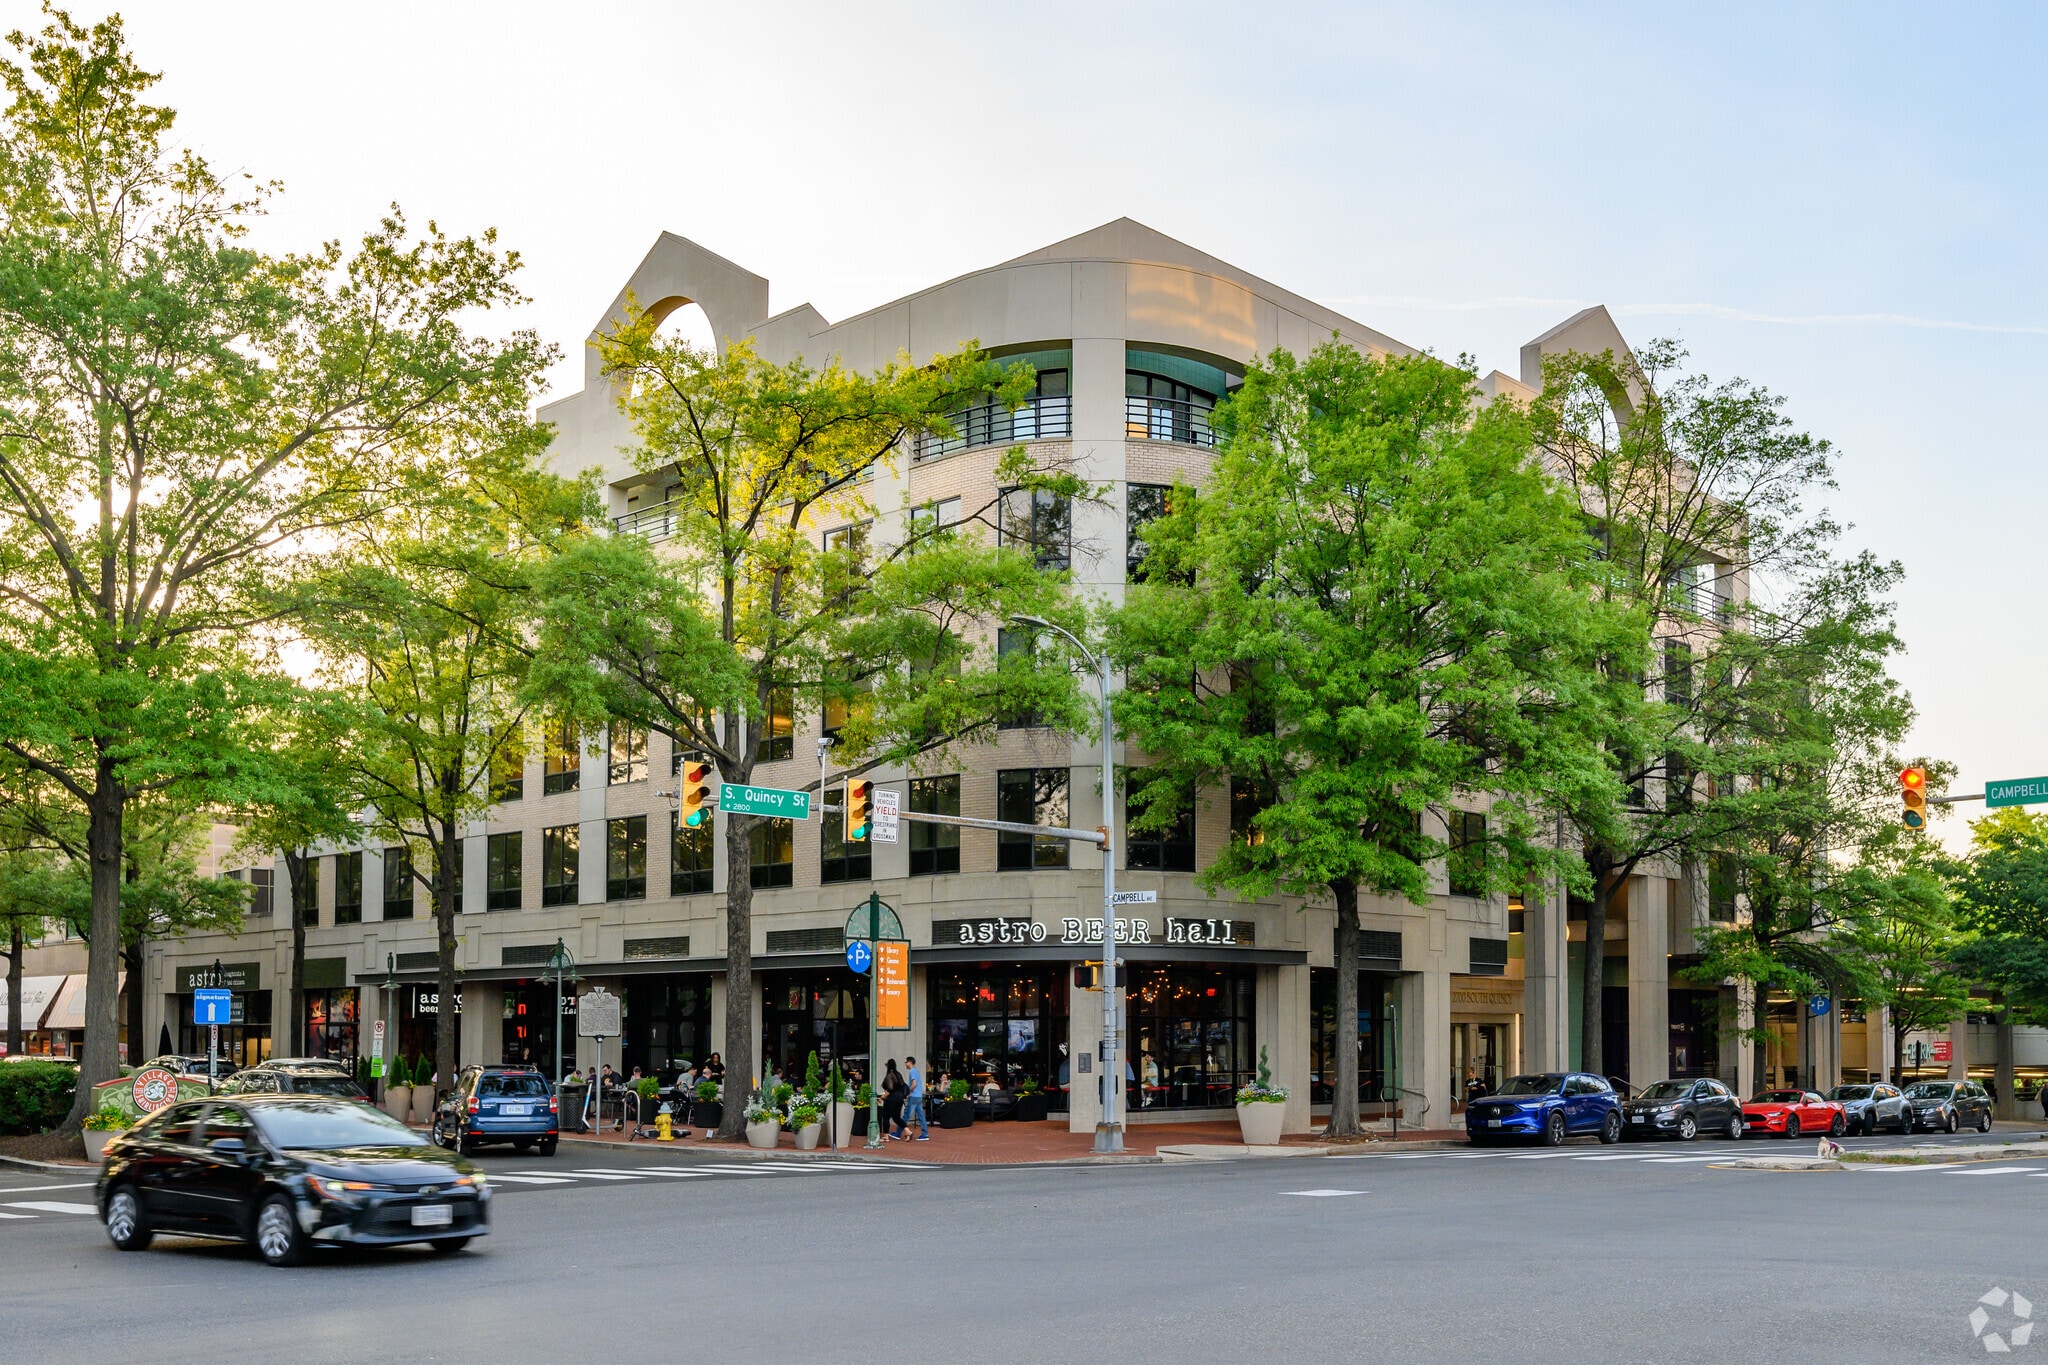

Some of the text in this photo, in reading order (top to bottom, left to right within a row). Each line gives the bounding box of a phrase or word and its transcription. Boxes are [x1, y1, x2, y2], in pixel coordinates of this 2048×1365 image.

[725, 787, 805, 807] S. Quincy St
[1991, 783, 2048, 799] CAMPBELL
[733, 803, 750, 811] 2800
[876, 806, 896, 816] YIELD
[1113, 893, 1145, 902] CAMPBELL
[959, 917, 1237, 944] astro BEER hall
[856, 950, 864, 964] P
[1466, 992, 1488, 1004] SOUTH
[1488, 992, 1512, 1004] QUINCY
[1818, 1000, 1824, 1010] P
[137, 1072, 173, 1086] VILLAGE
